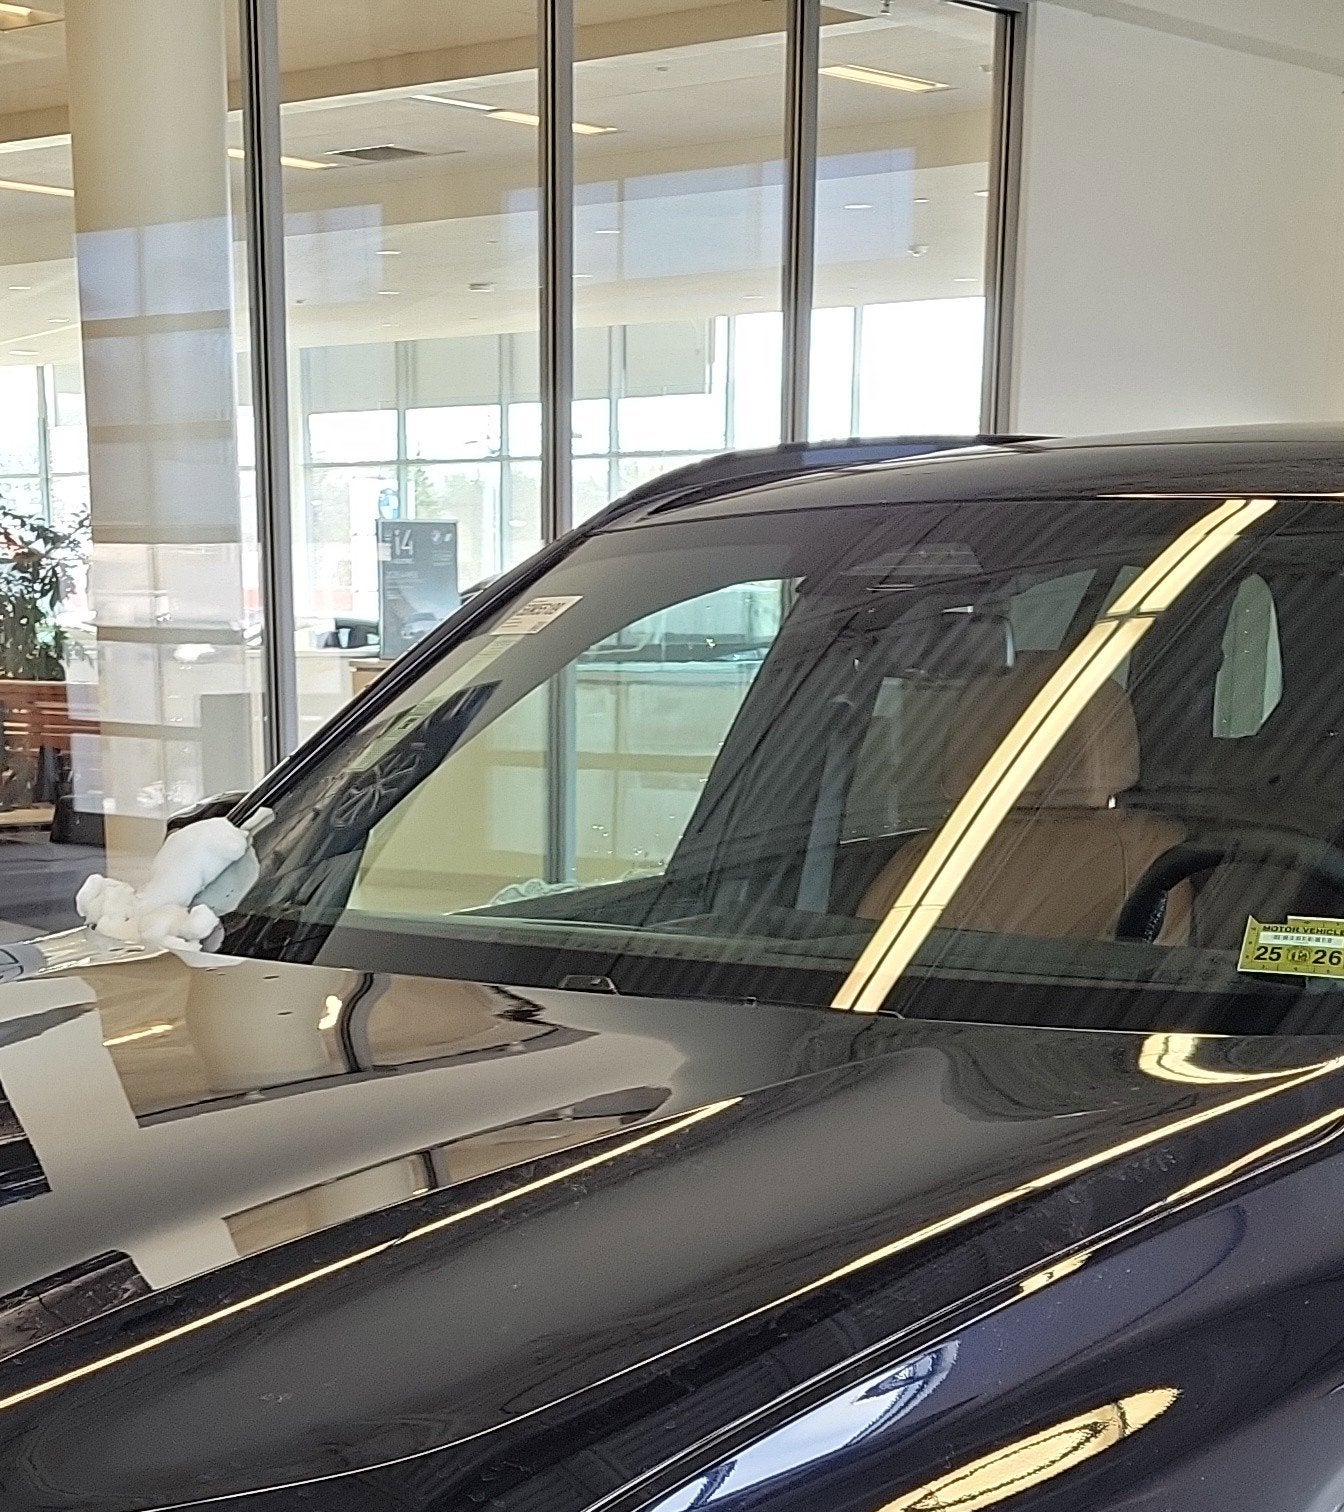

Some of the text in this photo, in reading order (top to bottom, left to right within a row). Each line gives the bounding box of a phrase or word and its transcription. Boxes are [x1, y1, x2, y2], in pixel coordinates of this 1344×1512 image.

[1262, 925, 1299, 933] MOTOR
[1254, 945, 1343, 966] 25 26
